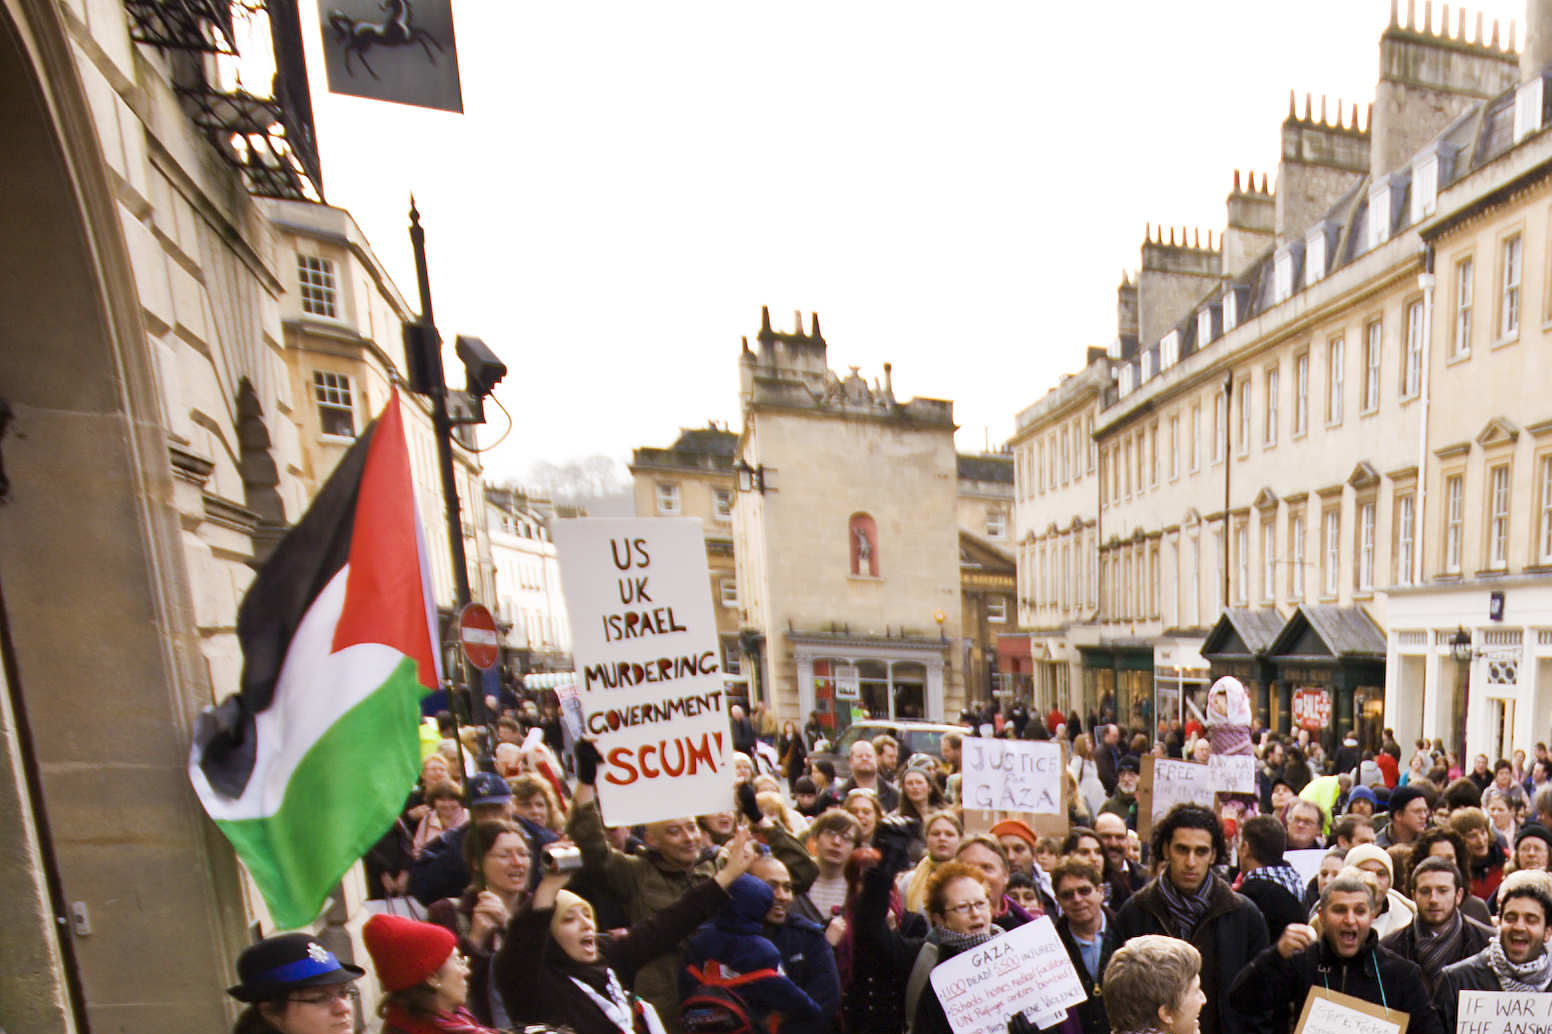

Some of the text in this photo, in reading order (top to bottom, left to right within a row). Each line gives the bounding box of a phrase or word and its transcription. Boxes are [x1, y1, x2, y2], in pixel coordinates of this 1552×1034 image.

[610, 538, 650, 571] US
[618, 576, 653, 604] UK
[602, 607, 687, 642] ISRAEL
[583, 651, 719, 691] MURDERING
[587, 690, 722, 734] GOVERNMENT
[604, 732, 725, 785] SCUM!
[970, 746, 1057, 771] JUSTICE
[1156, 763, 1194, 780] FREE
[1221, 771, 1252, 781] KILLED
[975, 785, 1054, 808] GAZA
[971, 942, 1014, 967] GAZA
[966, 967, 992, 987] DEAD!
[1312, 1005, 1343, 1023] STOP
[1466, 997, 1486, 1015] IF
[1496, 998, 1536, 1017] WAR
[955, 1013, 973, 1028] UN
